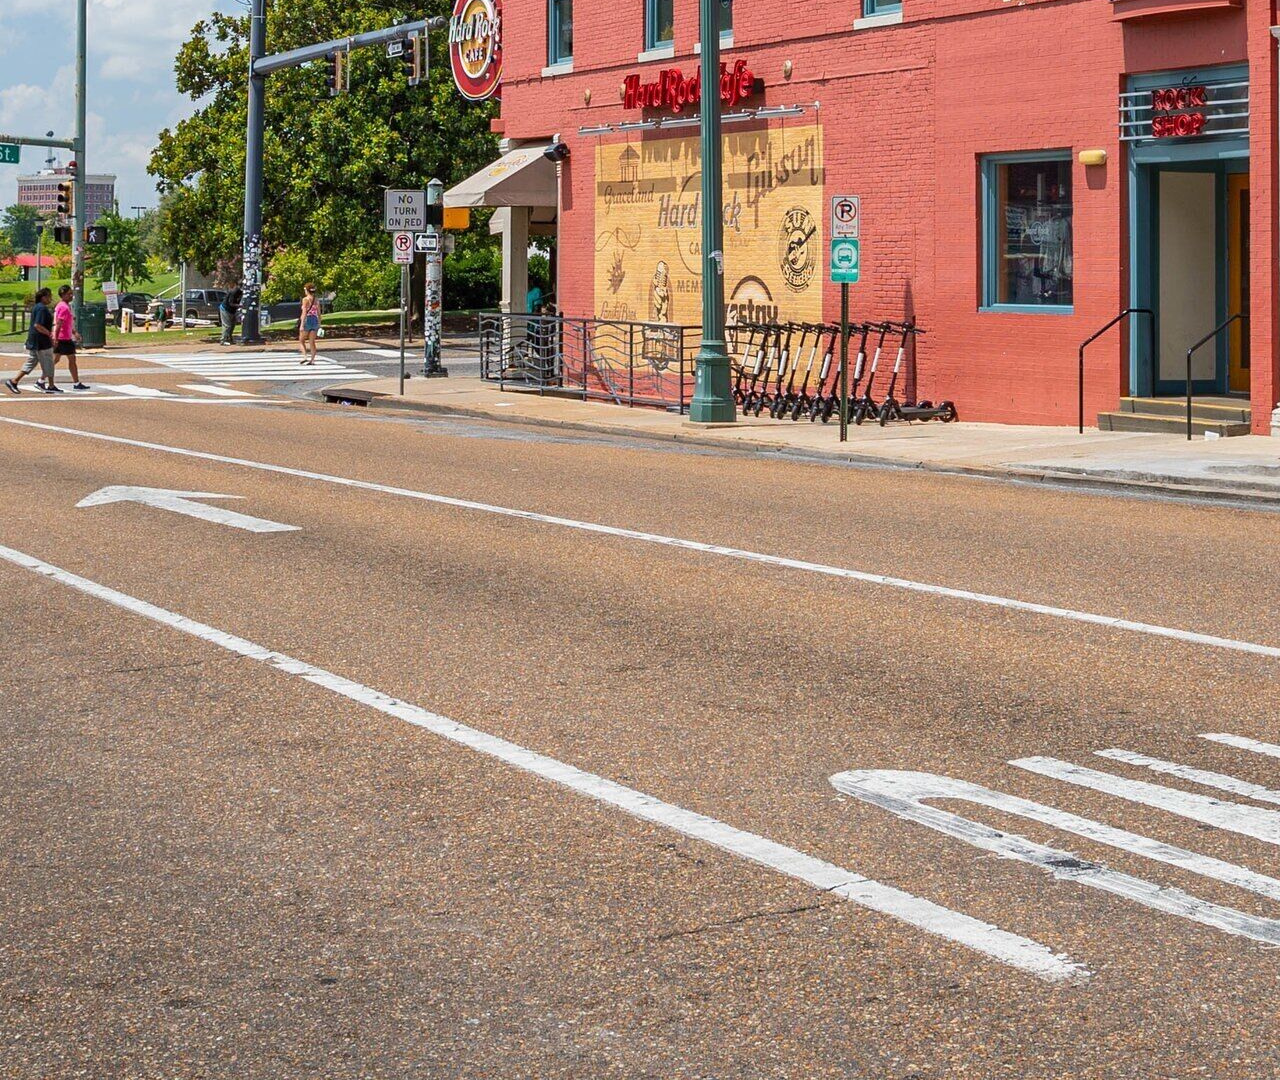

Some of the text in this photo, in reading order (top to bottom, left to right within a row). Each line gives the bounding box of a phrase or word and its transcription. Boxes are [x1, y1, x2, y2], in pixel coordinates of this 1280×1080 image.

[448, 12, 500, 44] Hard Rock
[464, 46, 484, 63] CAFE
[623, 70, 667, 110] Hard
[664, 66, 701, 113] Roc
[1152, 86, 1206, 110] ROCK
[1151, 112, 1206, 138] SHOP
[393, 207, 417, 215] TURN
[398, 195, 413, 204] NO
[604, 182, 655, 216] Graceland
[657, 191, 700, 228] Hard
[388, 218, 422, 228] ON RED
